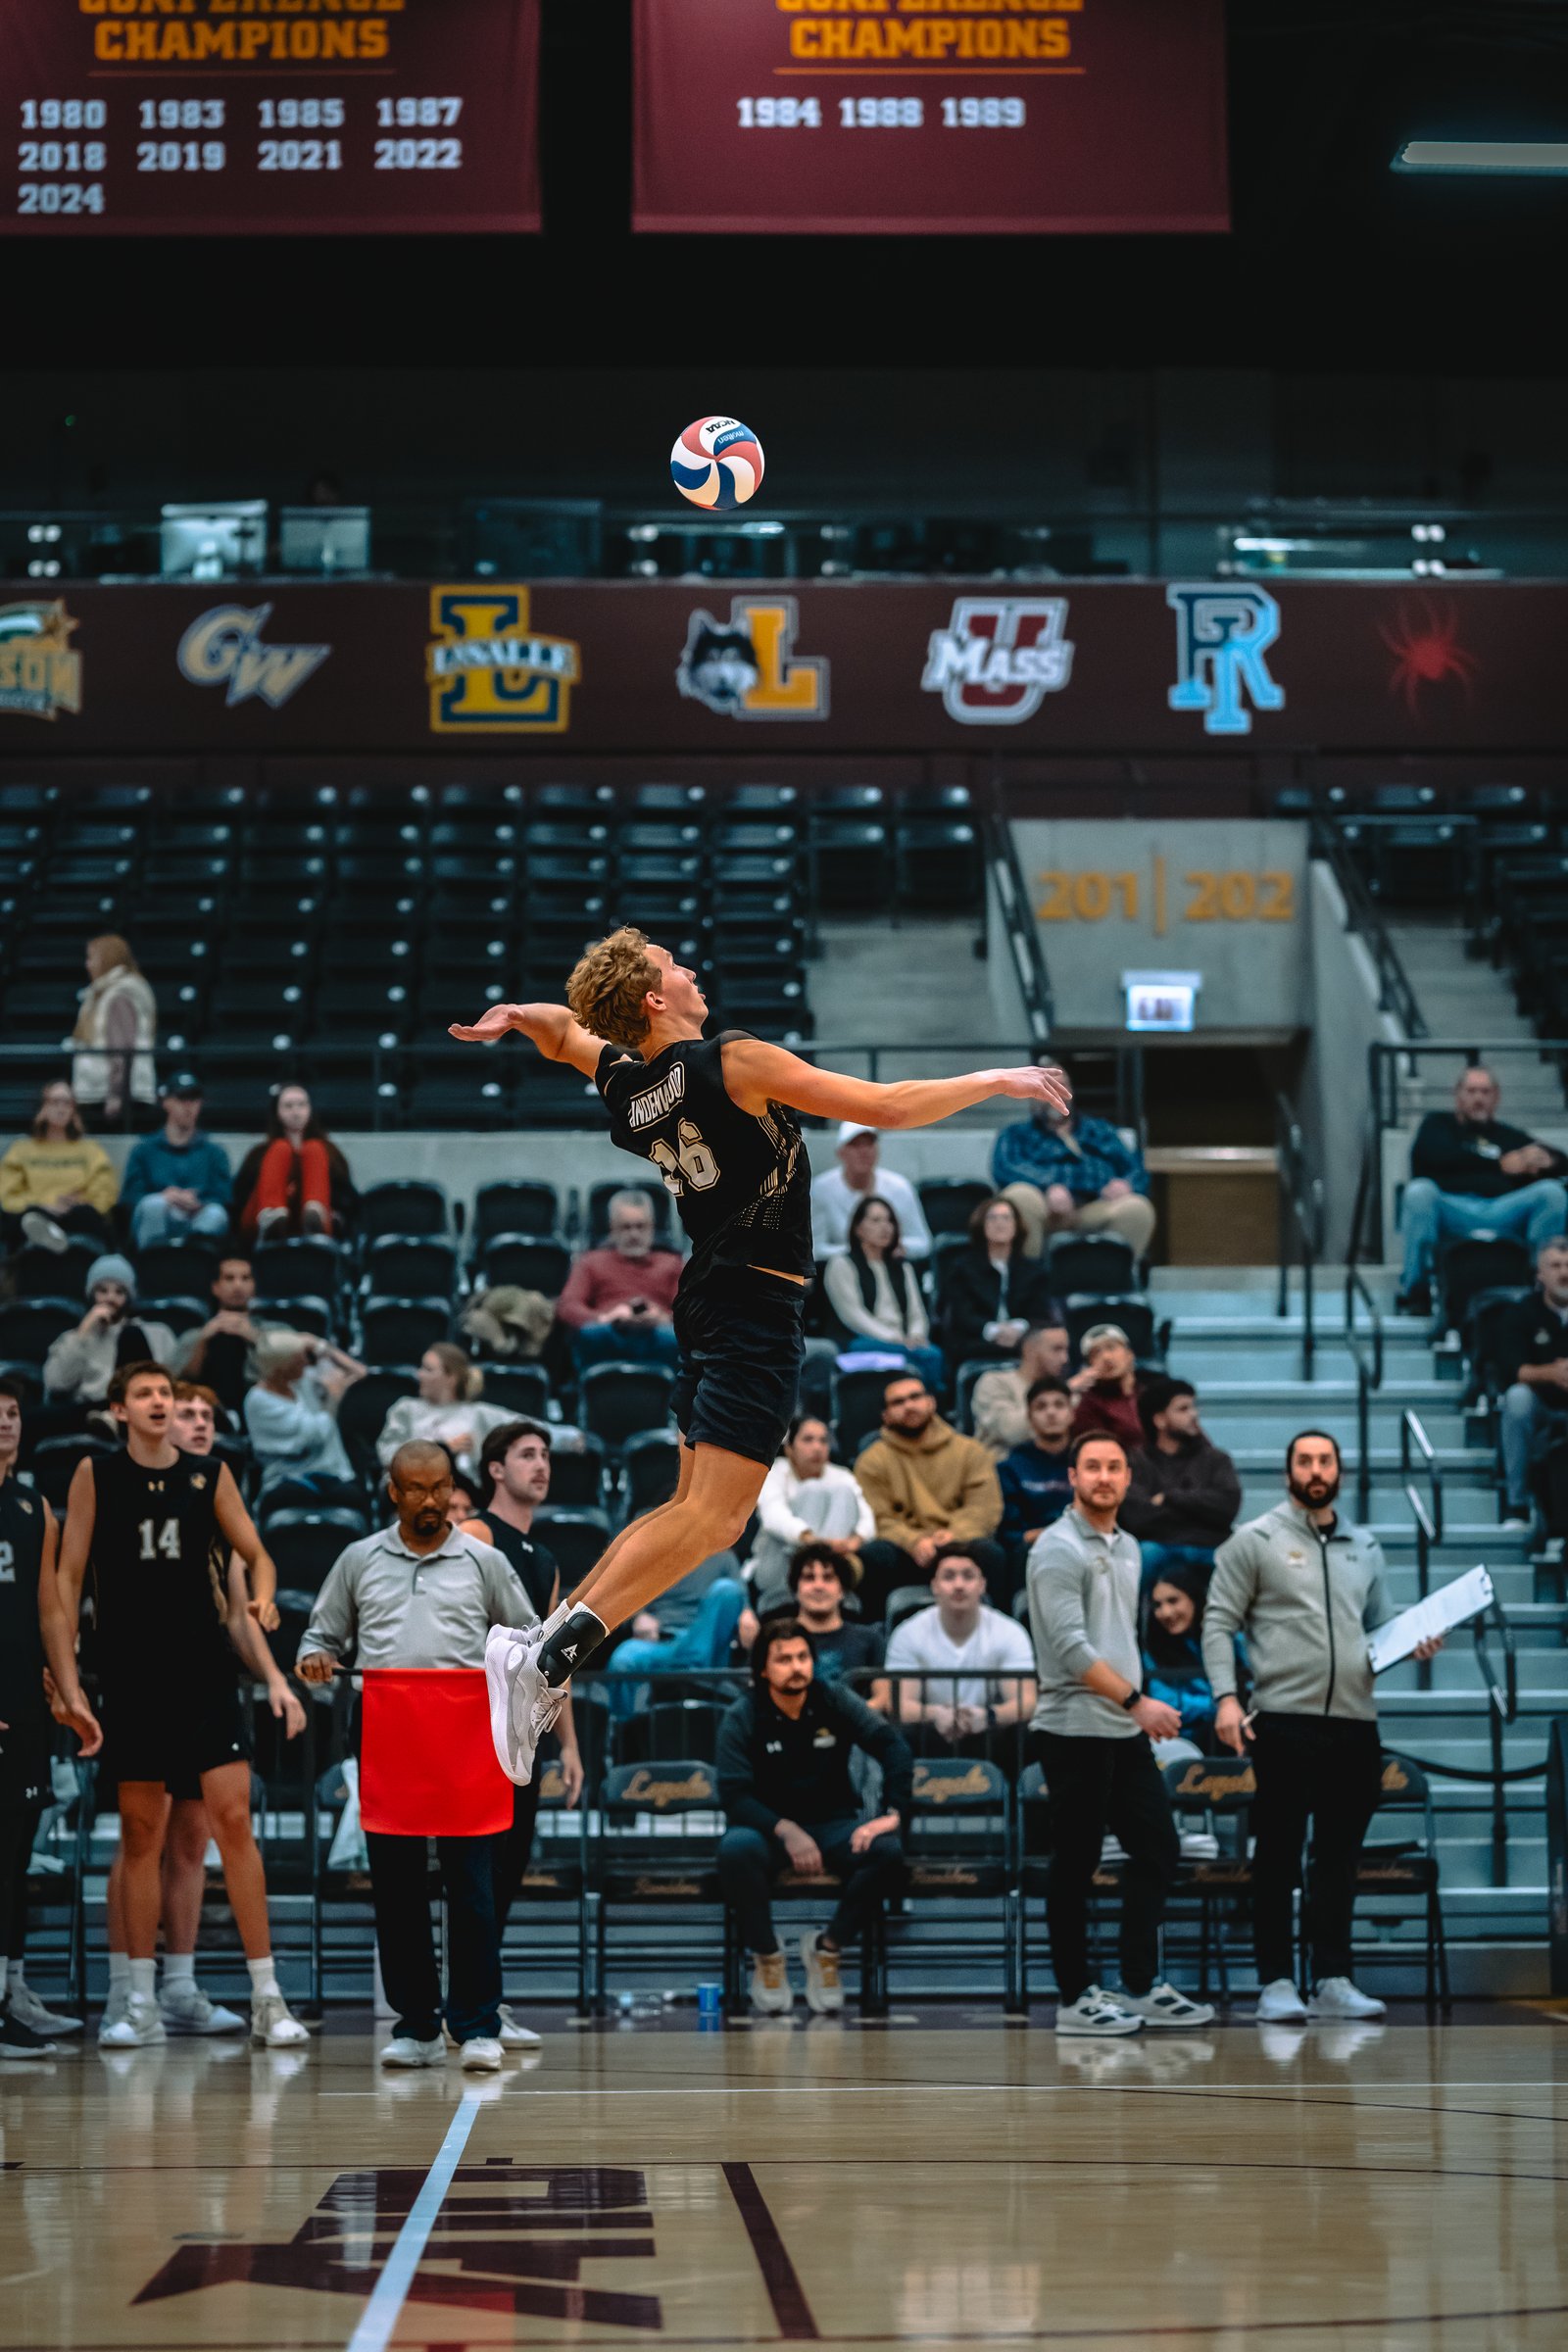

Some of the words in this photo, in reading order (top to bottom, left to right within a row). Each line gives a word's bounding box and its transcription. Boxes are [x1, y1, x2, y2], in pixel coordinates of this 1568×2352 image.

[94, 19, 389, 61] CHAMPIONS
[790, 18, 1070, 59] CHAMPIONS
[376, 96, 463, 127] 1987
[18, 141, 107, 172] 2018
[137, 141, 226, 172] 2019
[258, 139, 342, 171] 2021
[374, 138, 463, 170] 2022
[18, 183, 105, 214] 2024
[177, 602, 331, 709] GW
[1035, 871, 1138, 920] 201
[1183, 870, 1296, 921] 202
[138, 1518, 181, 1560] 14
